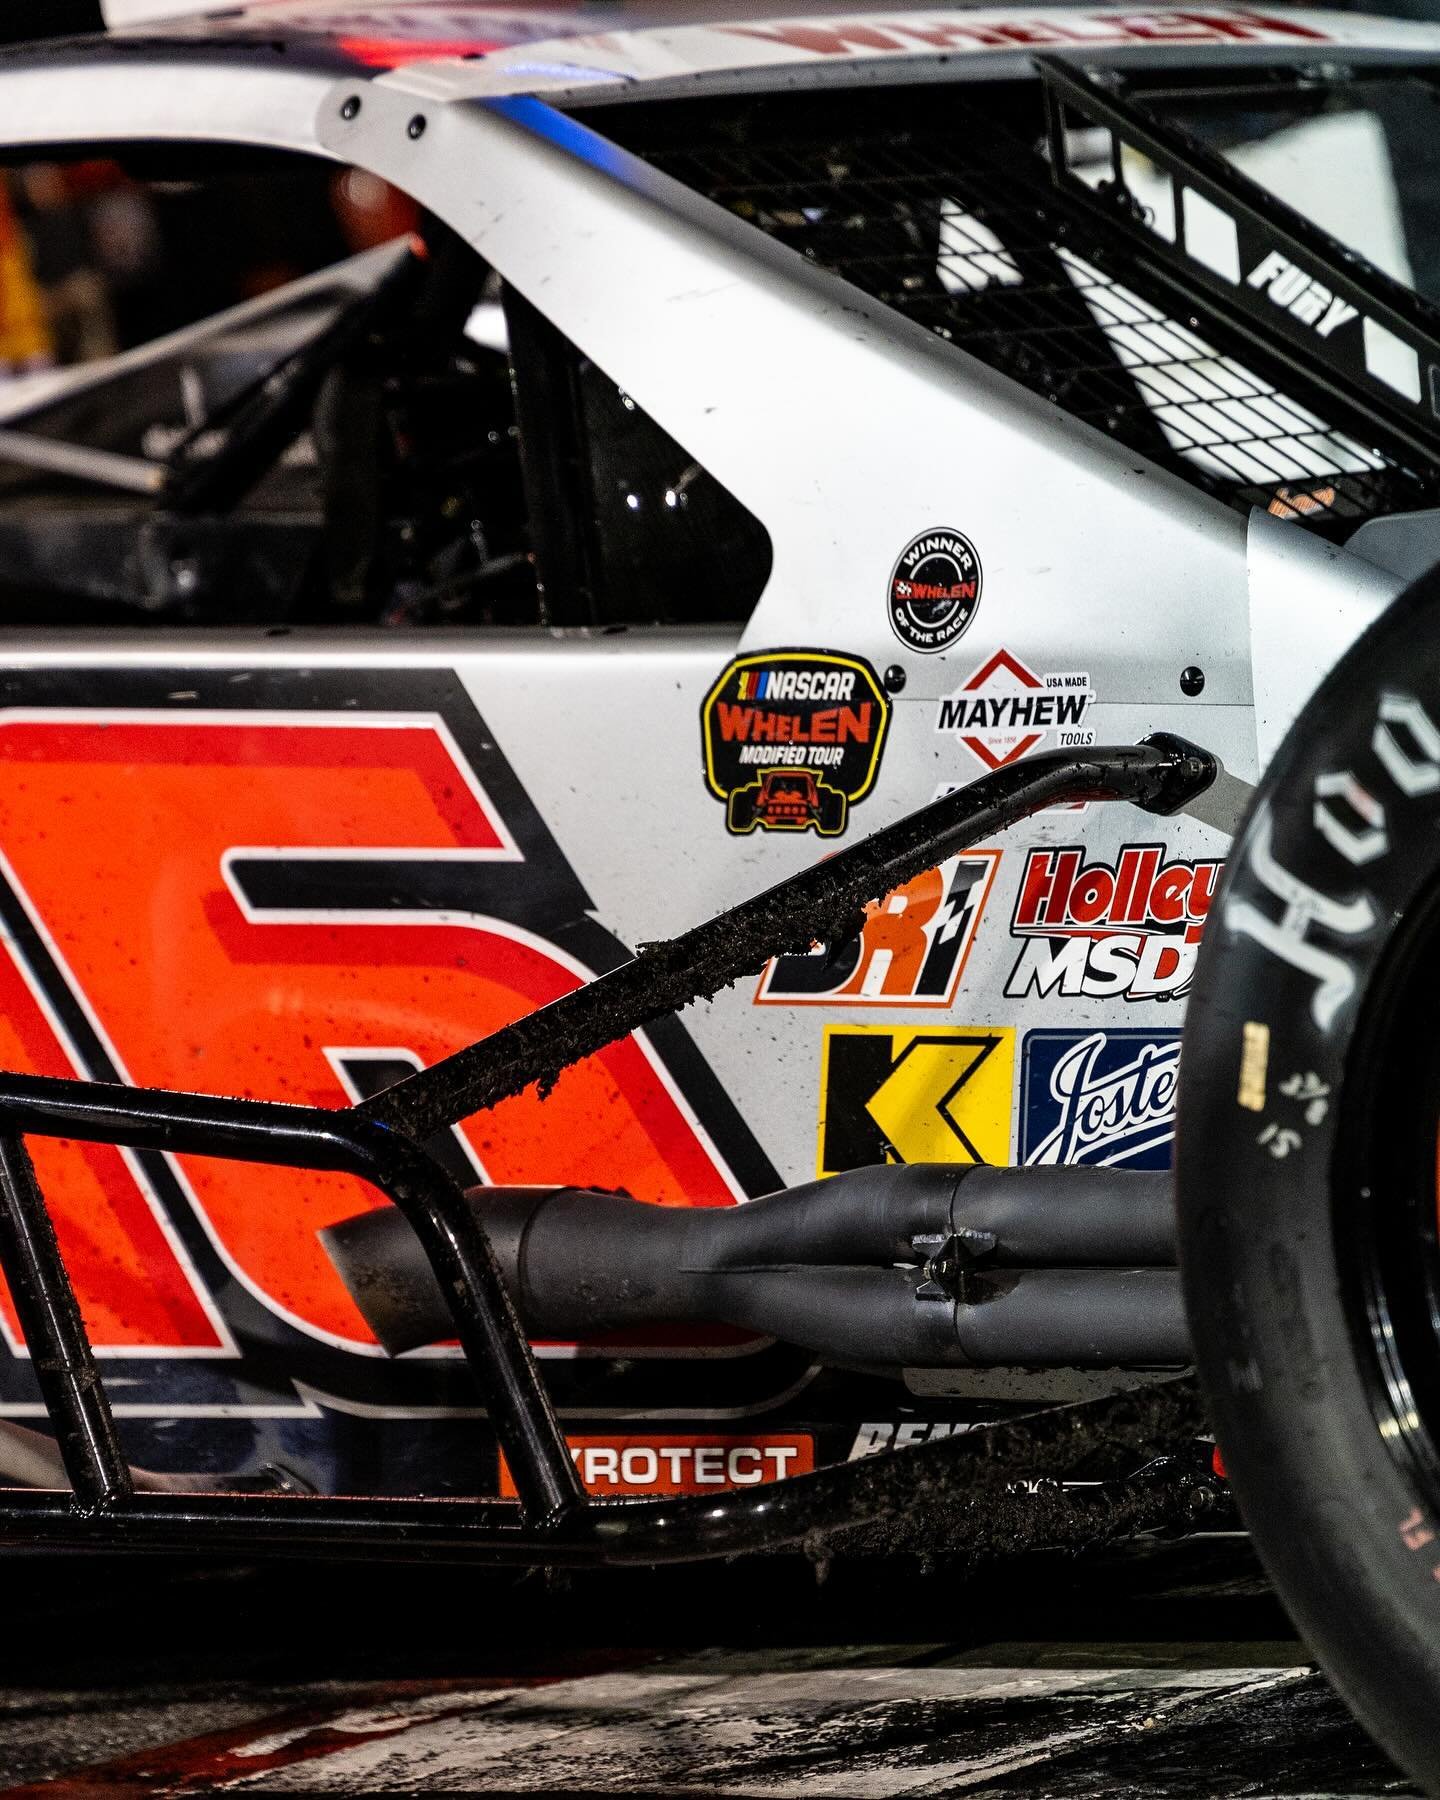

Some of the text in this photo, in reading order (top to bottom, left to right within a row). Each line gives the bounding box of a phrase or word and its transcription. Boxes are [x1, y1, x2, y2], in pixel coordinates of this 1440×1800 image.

[1247, 251, 1359, 337] FURY
[903, 537, 973, 571] WINNER
[911, 581, 976, 599] WHELEN
[895, 607, 969, 643] OF THE RACE
[764, 671, 856, 701] NASCAR
[1046, 677, 1087, 688] USA MADE
[716, 702, 872, 743] WHELEN
[938, 695, 1087, 729] MAYHEW
[739, 746, 844, 765] MODIFIED TOUR
[1060, 732, 1093, 746] TOOLS
[1004, 935, 1199, 997] MSD
